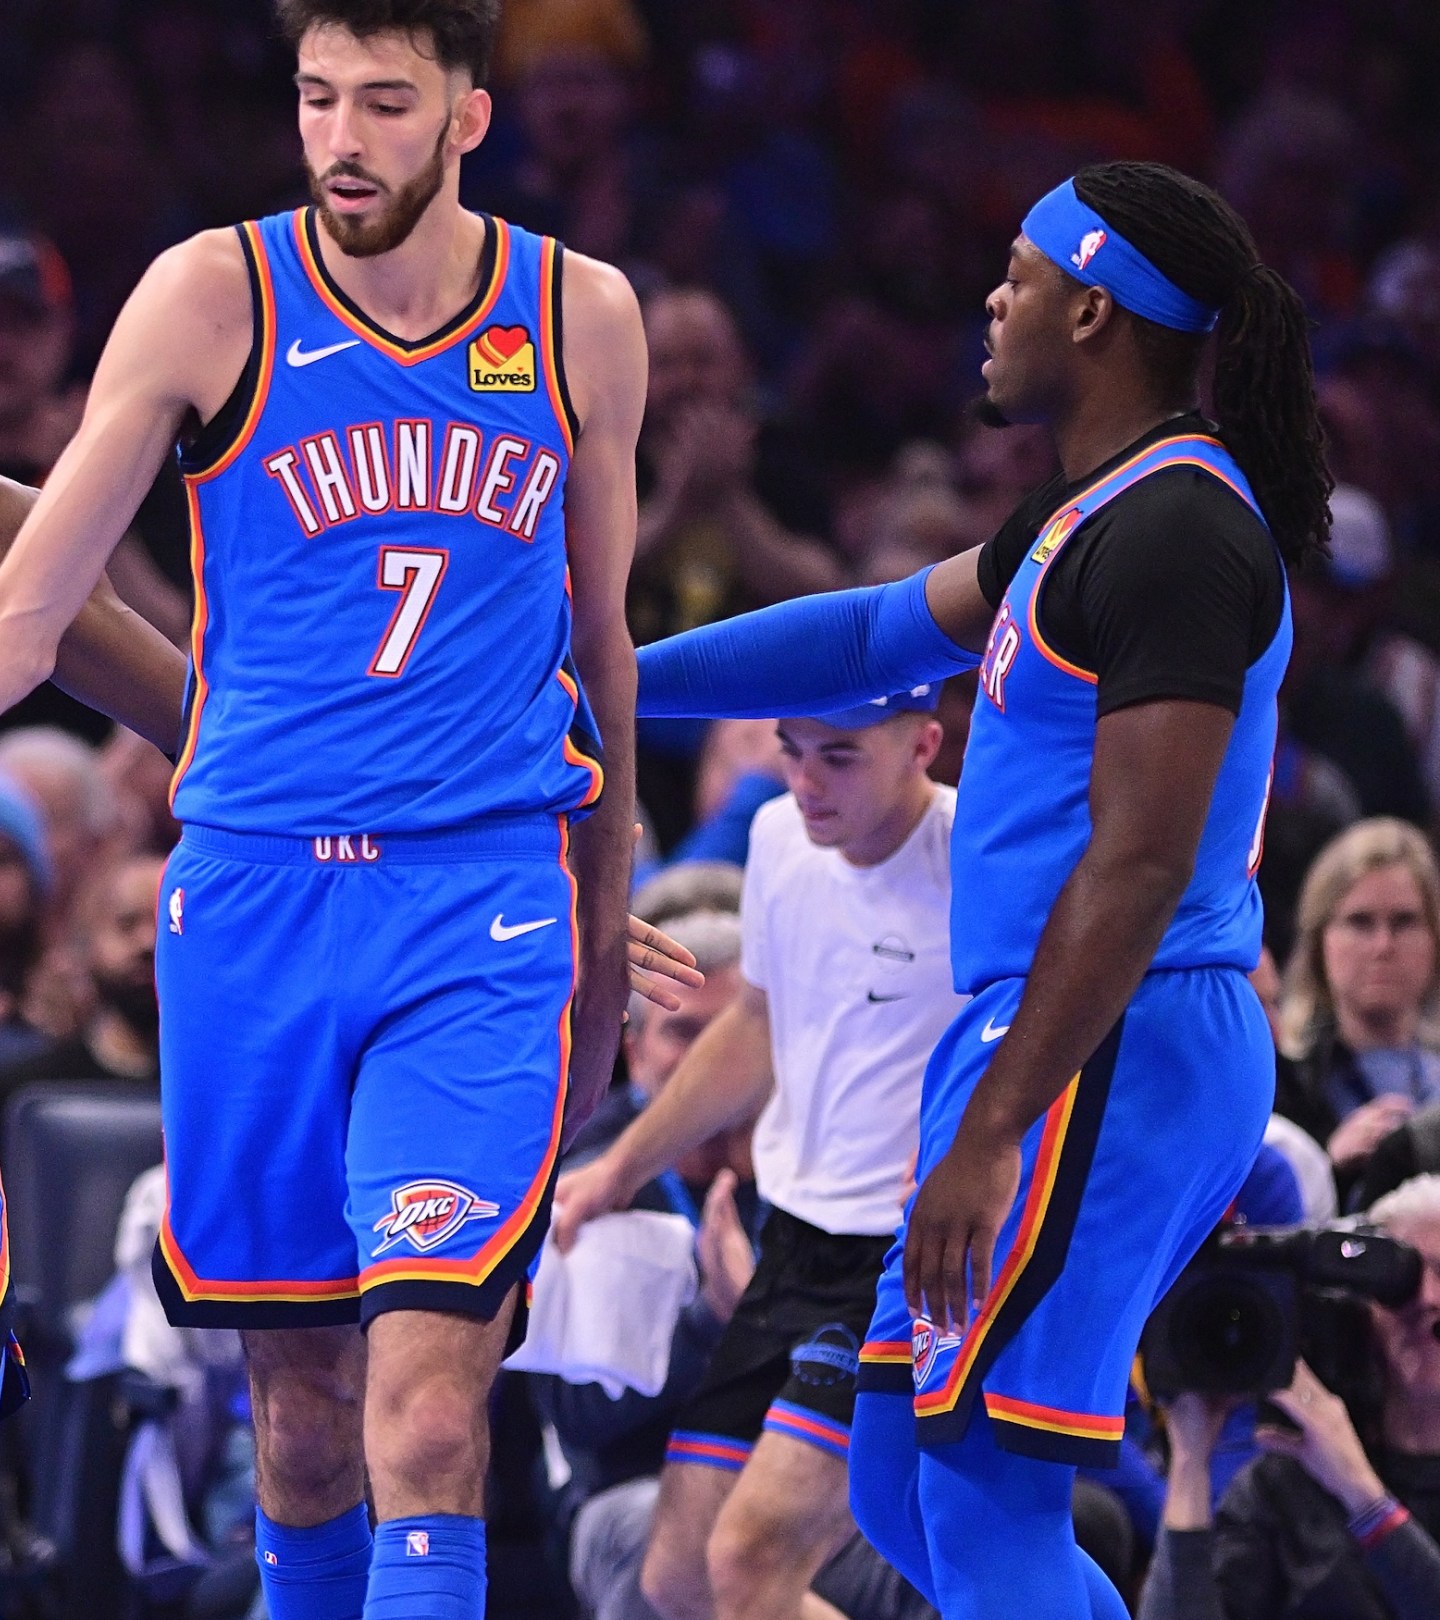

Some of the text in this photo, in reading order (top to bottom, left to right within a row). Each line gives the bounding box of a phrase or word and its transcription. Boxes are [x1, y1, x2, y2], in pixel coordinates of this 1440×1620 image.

[263, 419, 560, 543] THUNDER
[366, 545, 449, 678] 7
[388, 1196, 455, 1237] OKC
